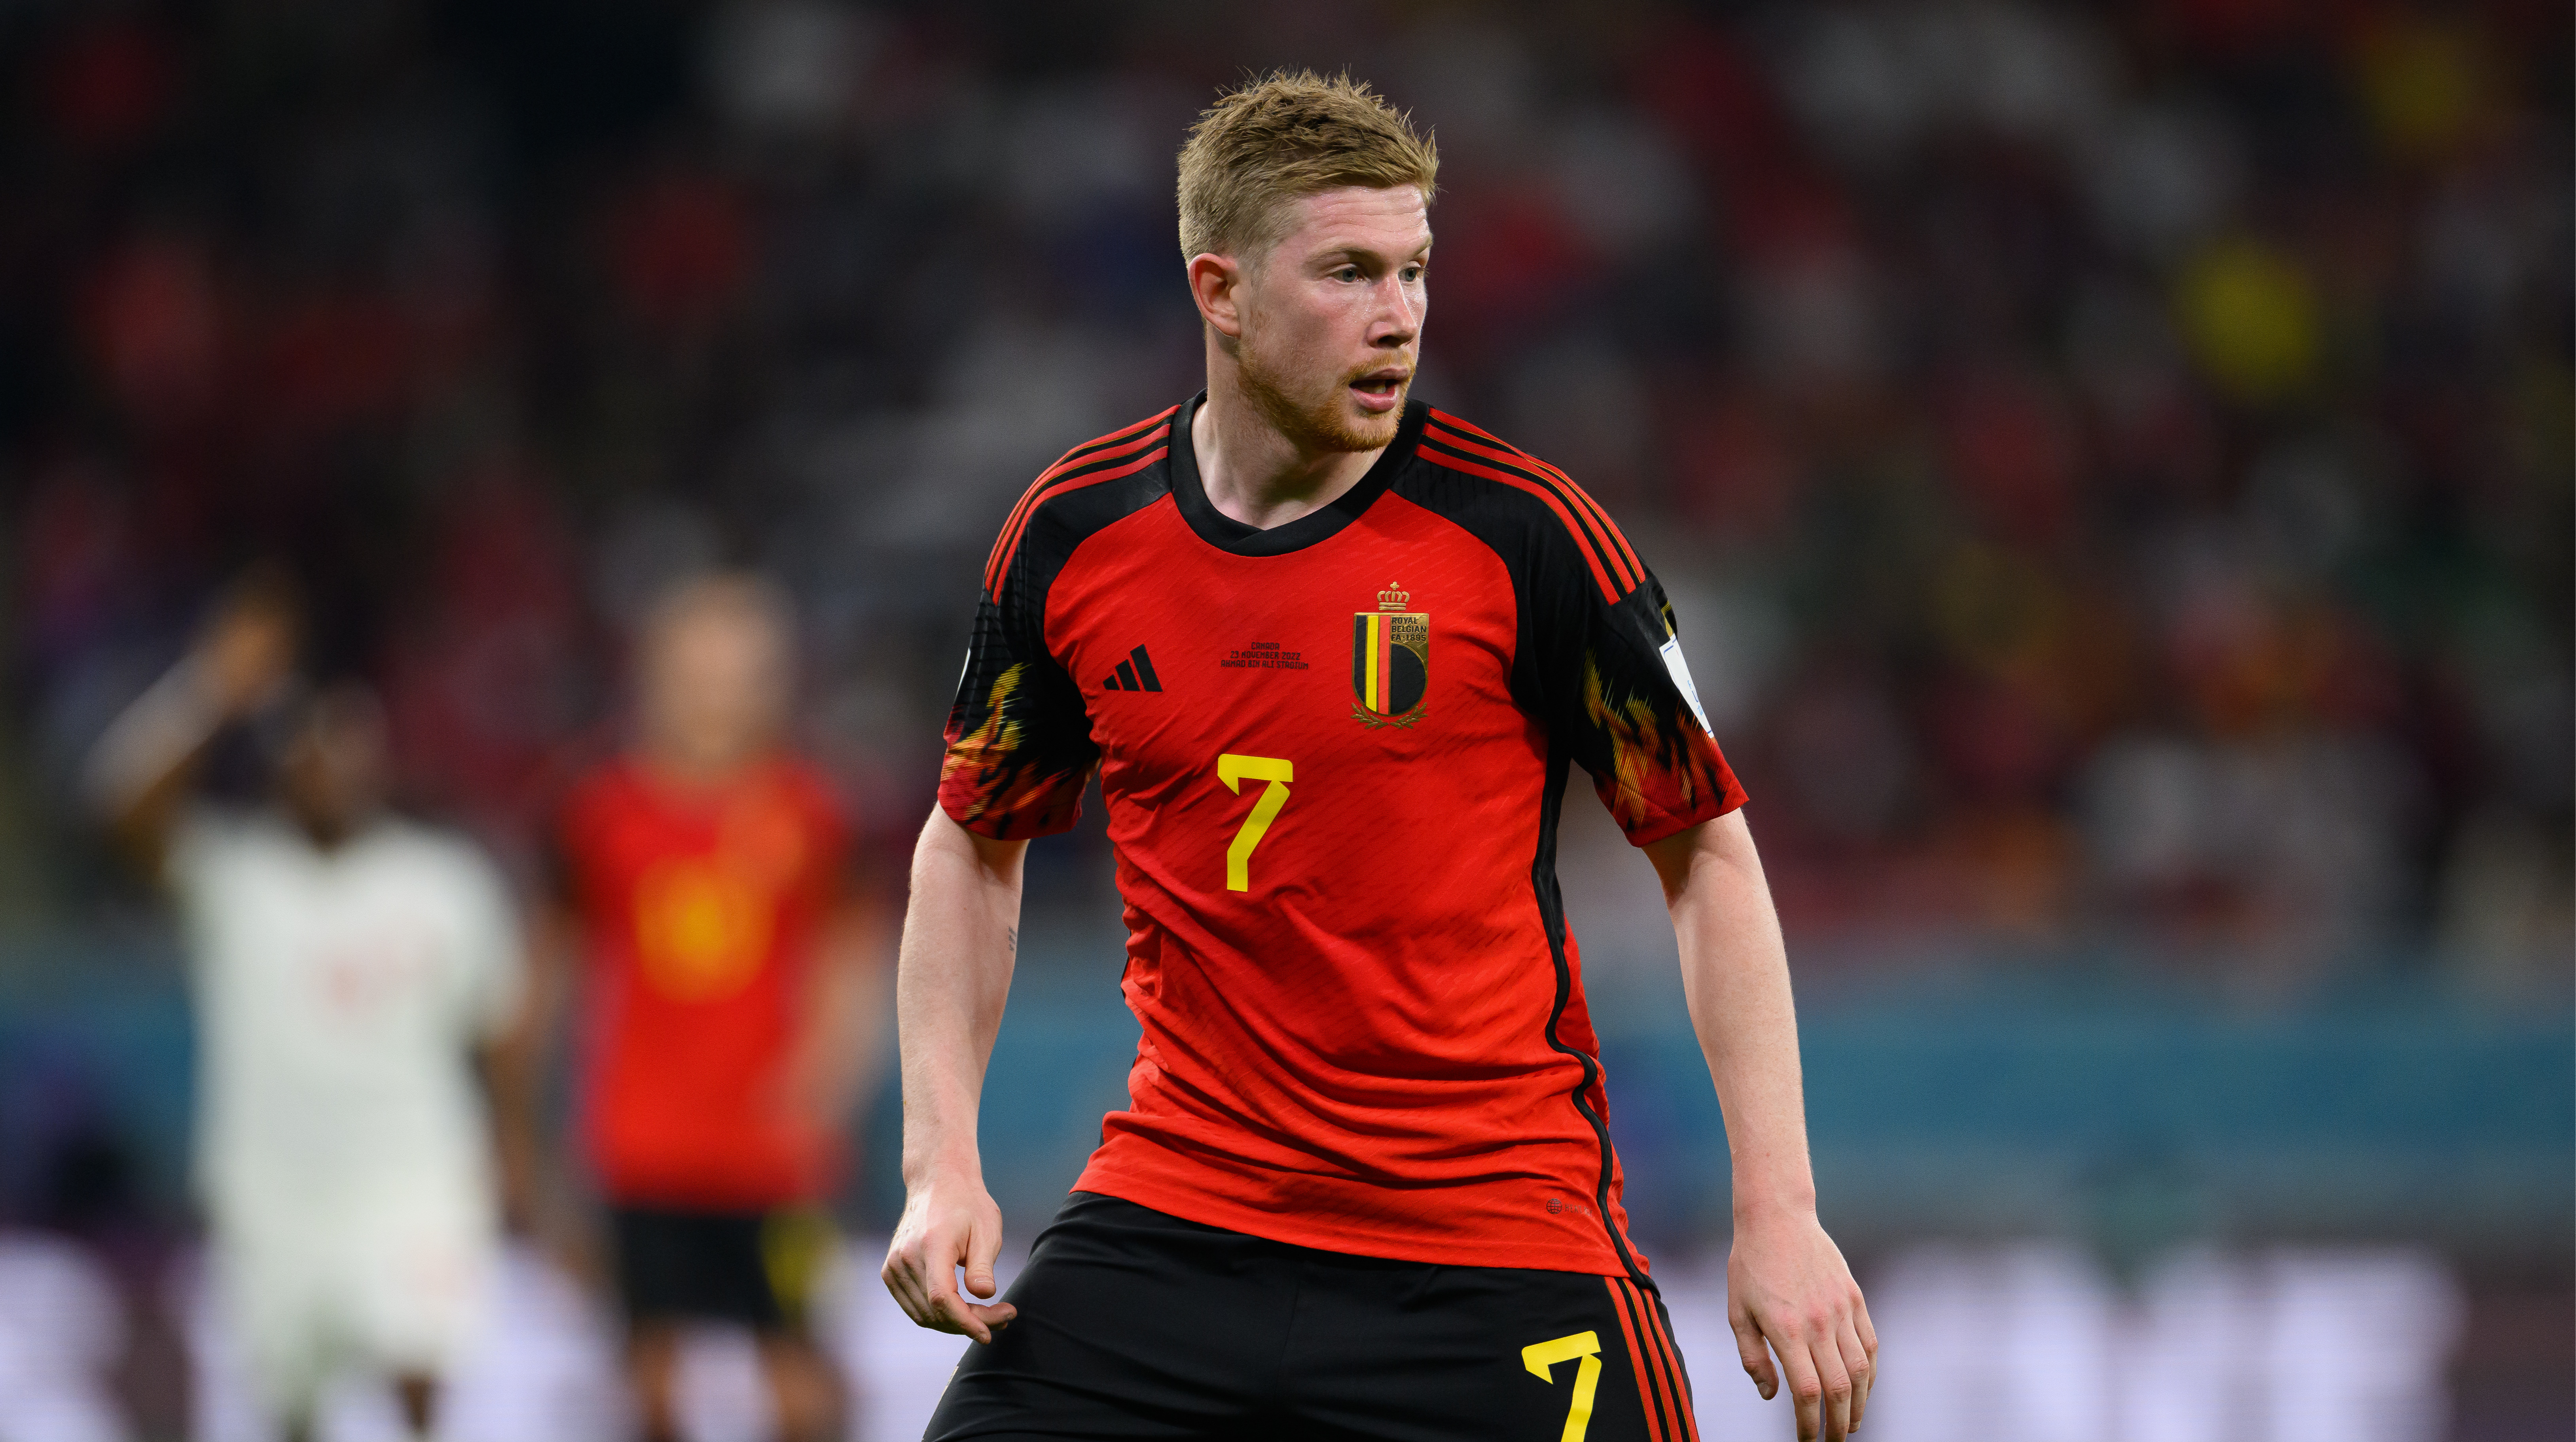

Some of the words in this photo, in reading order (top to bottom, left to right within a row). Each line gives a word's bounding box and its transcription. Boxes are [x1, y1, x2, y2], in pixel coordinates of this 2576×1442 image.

[1251, 642, 1280, 650] CANADA
[1242, 651, 1279, 659] NOVEMBER
[1282, 652, 1300, 660] 2022
[1276, 661, 1308, 670] STADIUM
[1217, 753, 1293, 892] 7
[1521, 1330, 1602, 1442] 7
